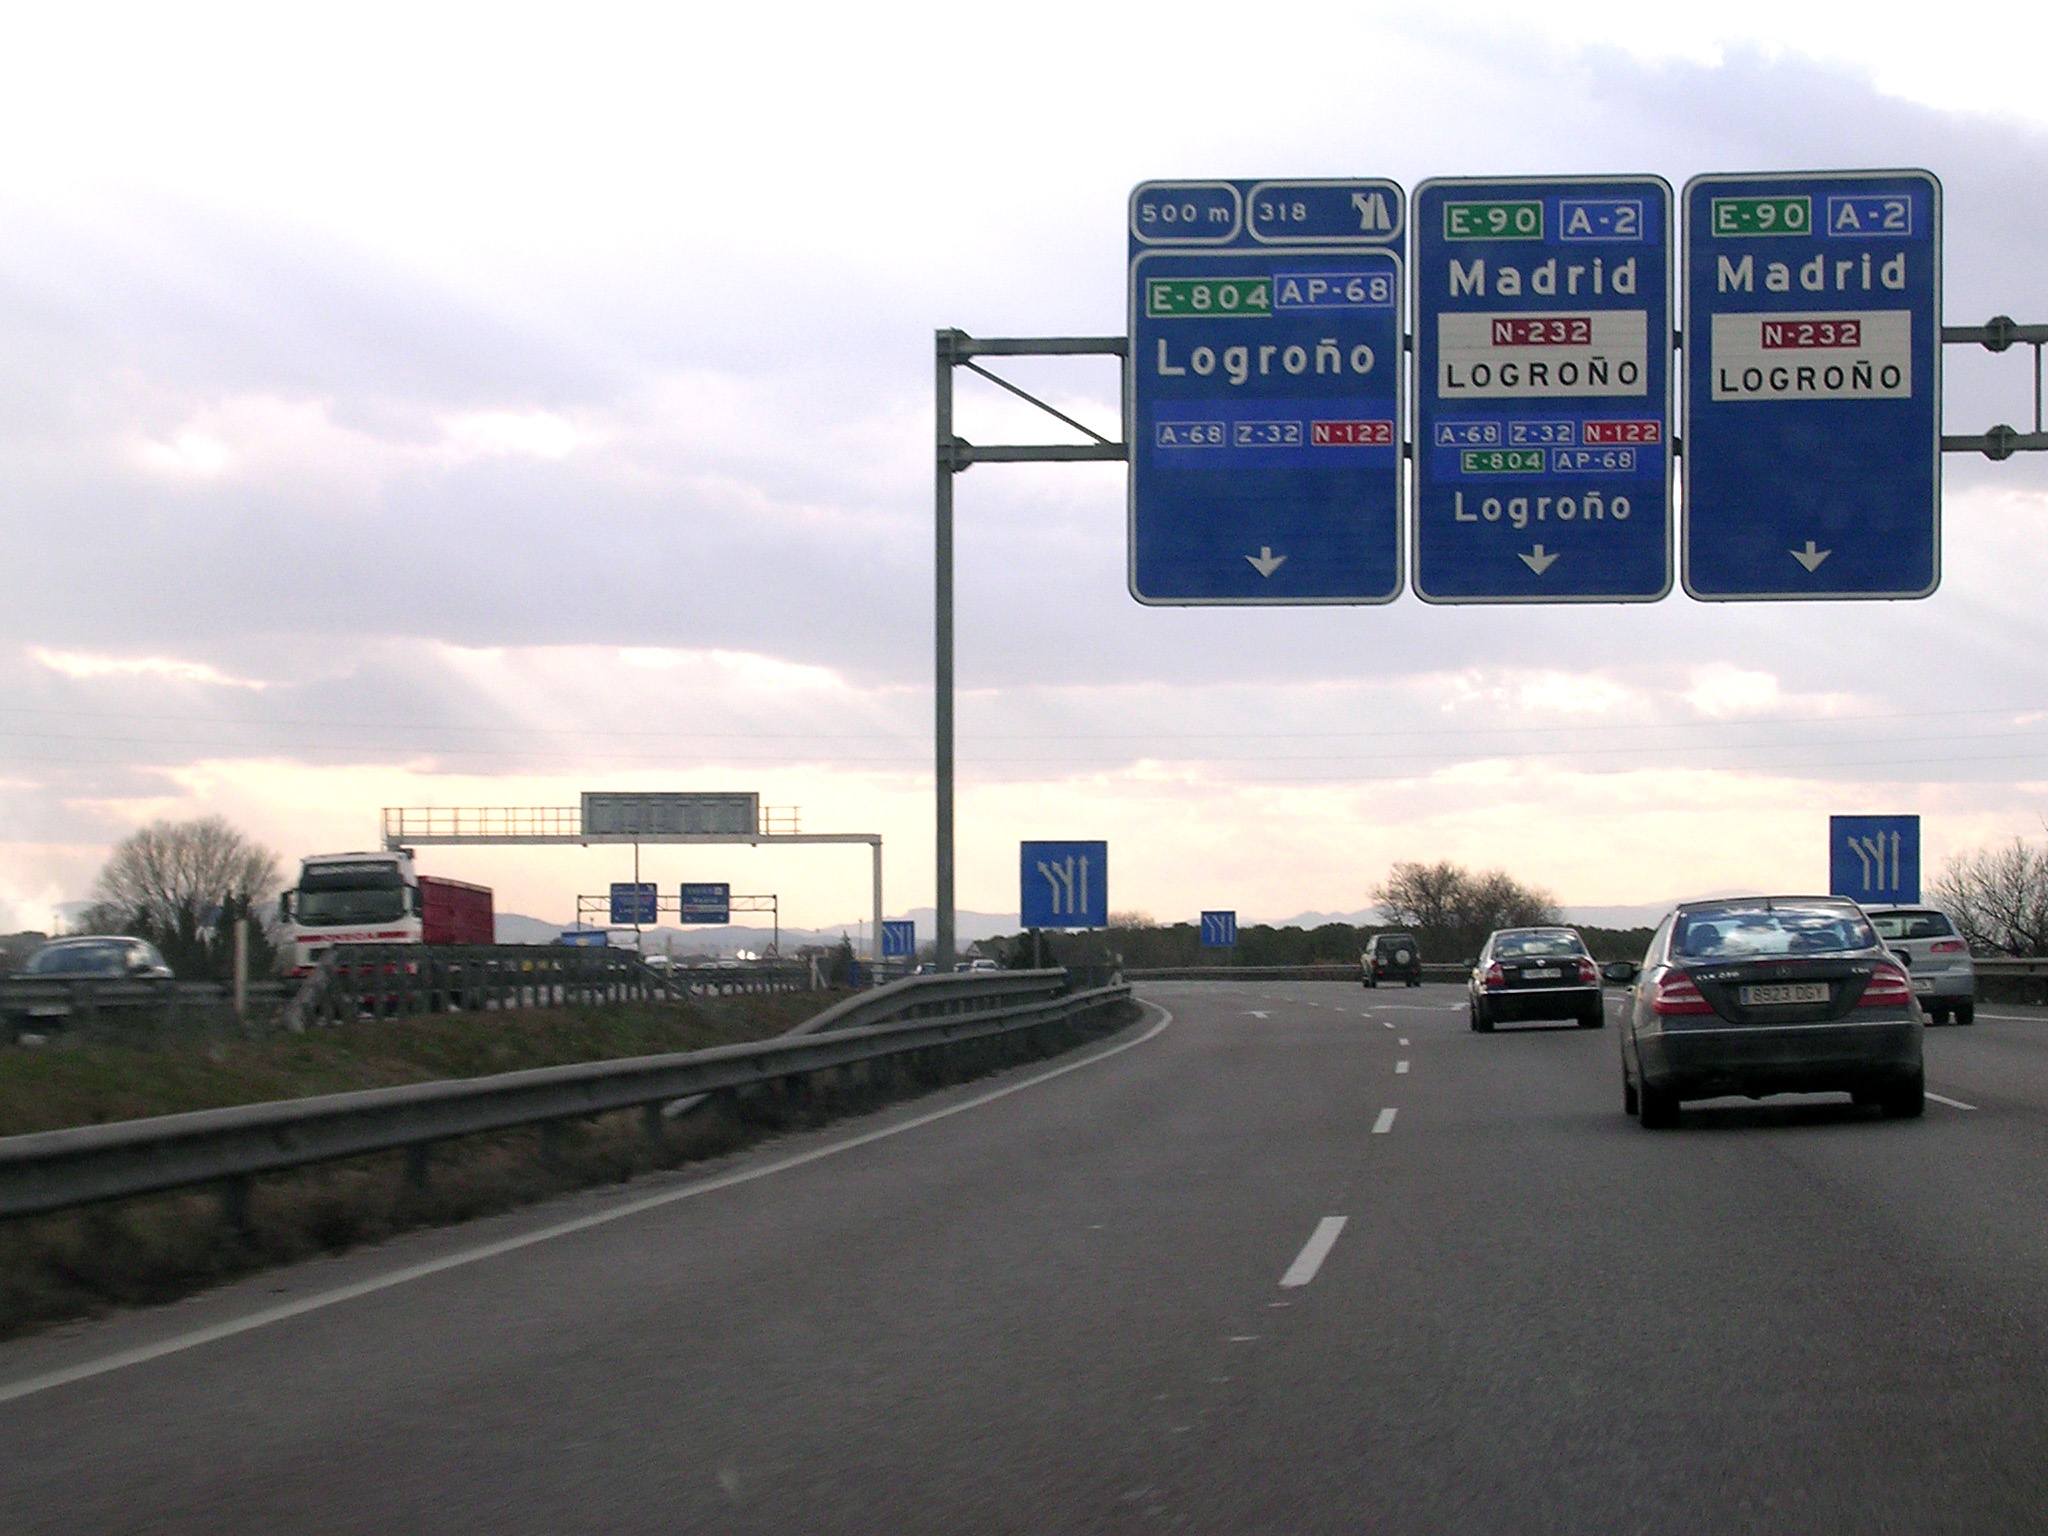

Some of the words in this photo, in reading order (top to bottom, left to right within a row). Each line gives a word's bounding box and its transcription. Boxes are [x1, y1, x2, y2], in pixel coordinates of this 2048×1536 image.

[1141, 203, 1198, 223] 500
[1208, 206, 1231, 223] m
[1258, 202, 1307, 222] 318
[1450, 207, 1537, 233] E-90
[1566, 206, 1637, 234] A-2
[1718, 202, 1805, 229] E-90
[1835, 201, 1906, 230] A-2
[1449, 256, 1637, 298] Madrid
[1717, 252, 1907, 294] Madrid
[1152, 284, 1271, 311] E-804
[1279, 277, 1389, 304] AP-68
[1494, 321, 1590, 343] N-232
[1764, 323, 1859, 347] N-232
[1156, 337, 1376, 386] Logroño
[1446, 355, 1639, 389] LOGROÑO
[1719, 359, 1902, 393] LOGROÑO
[1159, 424, 1223, 444] A-68
[1236, 423, 1300, 443] Z-32
[1314, 424, 1391, 443] N-122
[1439, 424, 1498, 443] A-68
[1512, 424, 1572, 443] Z-32
[1585, 423, 1658, 442] N-122
[1464, 451, 1542, 470] E-804
[1555, 451, 1633, 470] AP-68
[1454, 490, 1632, 530] Logroño
